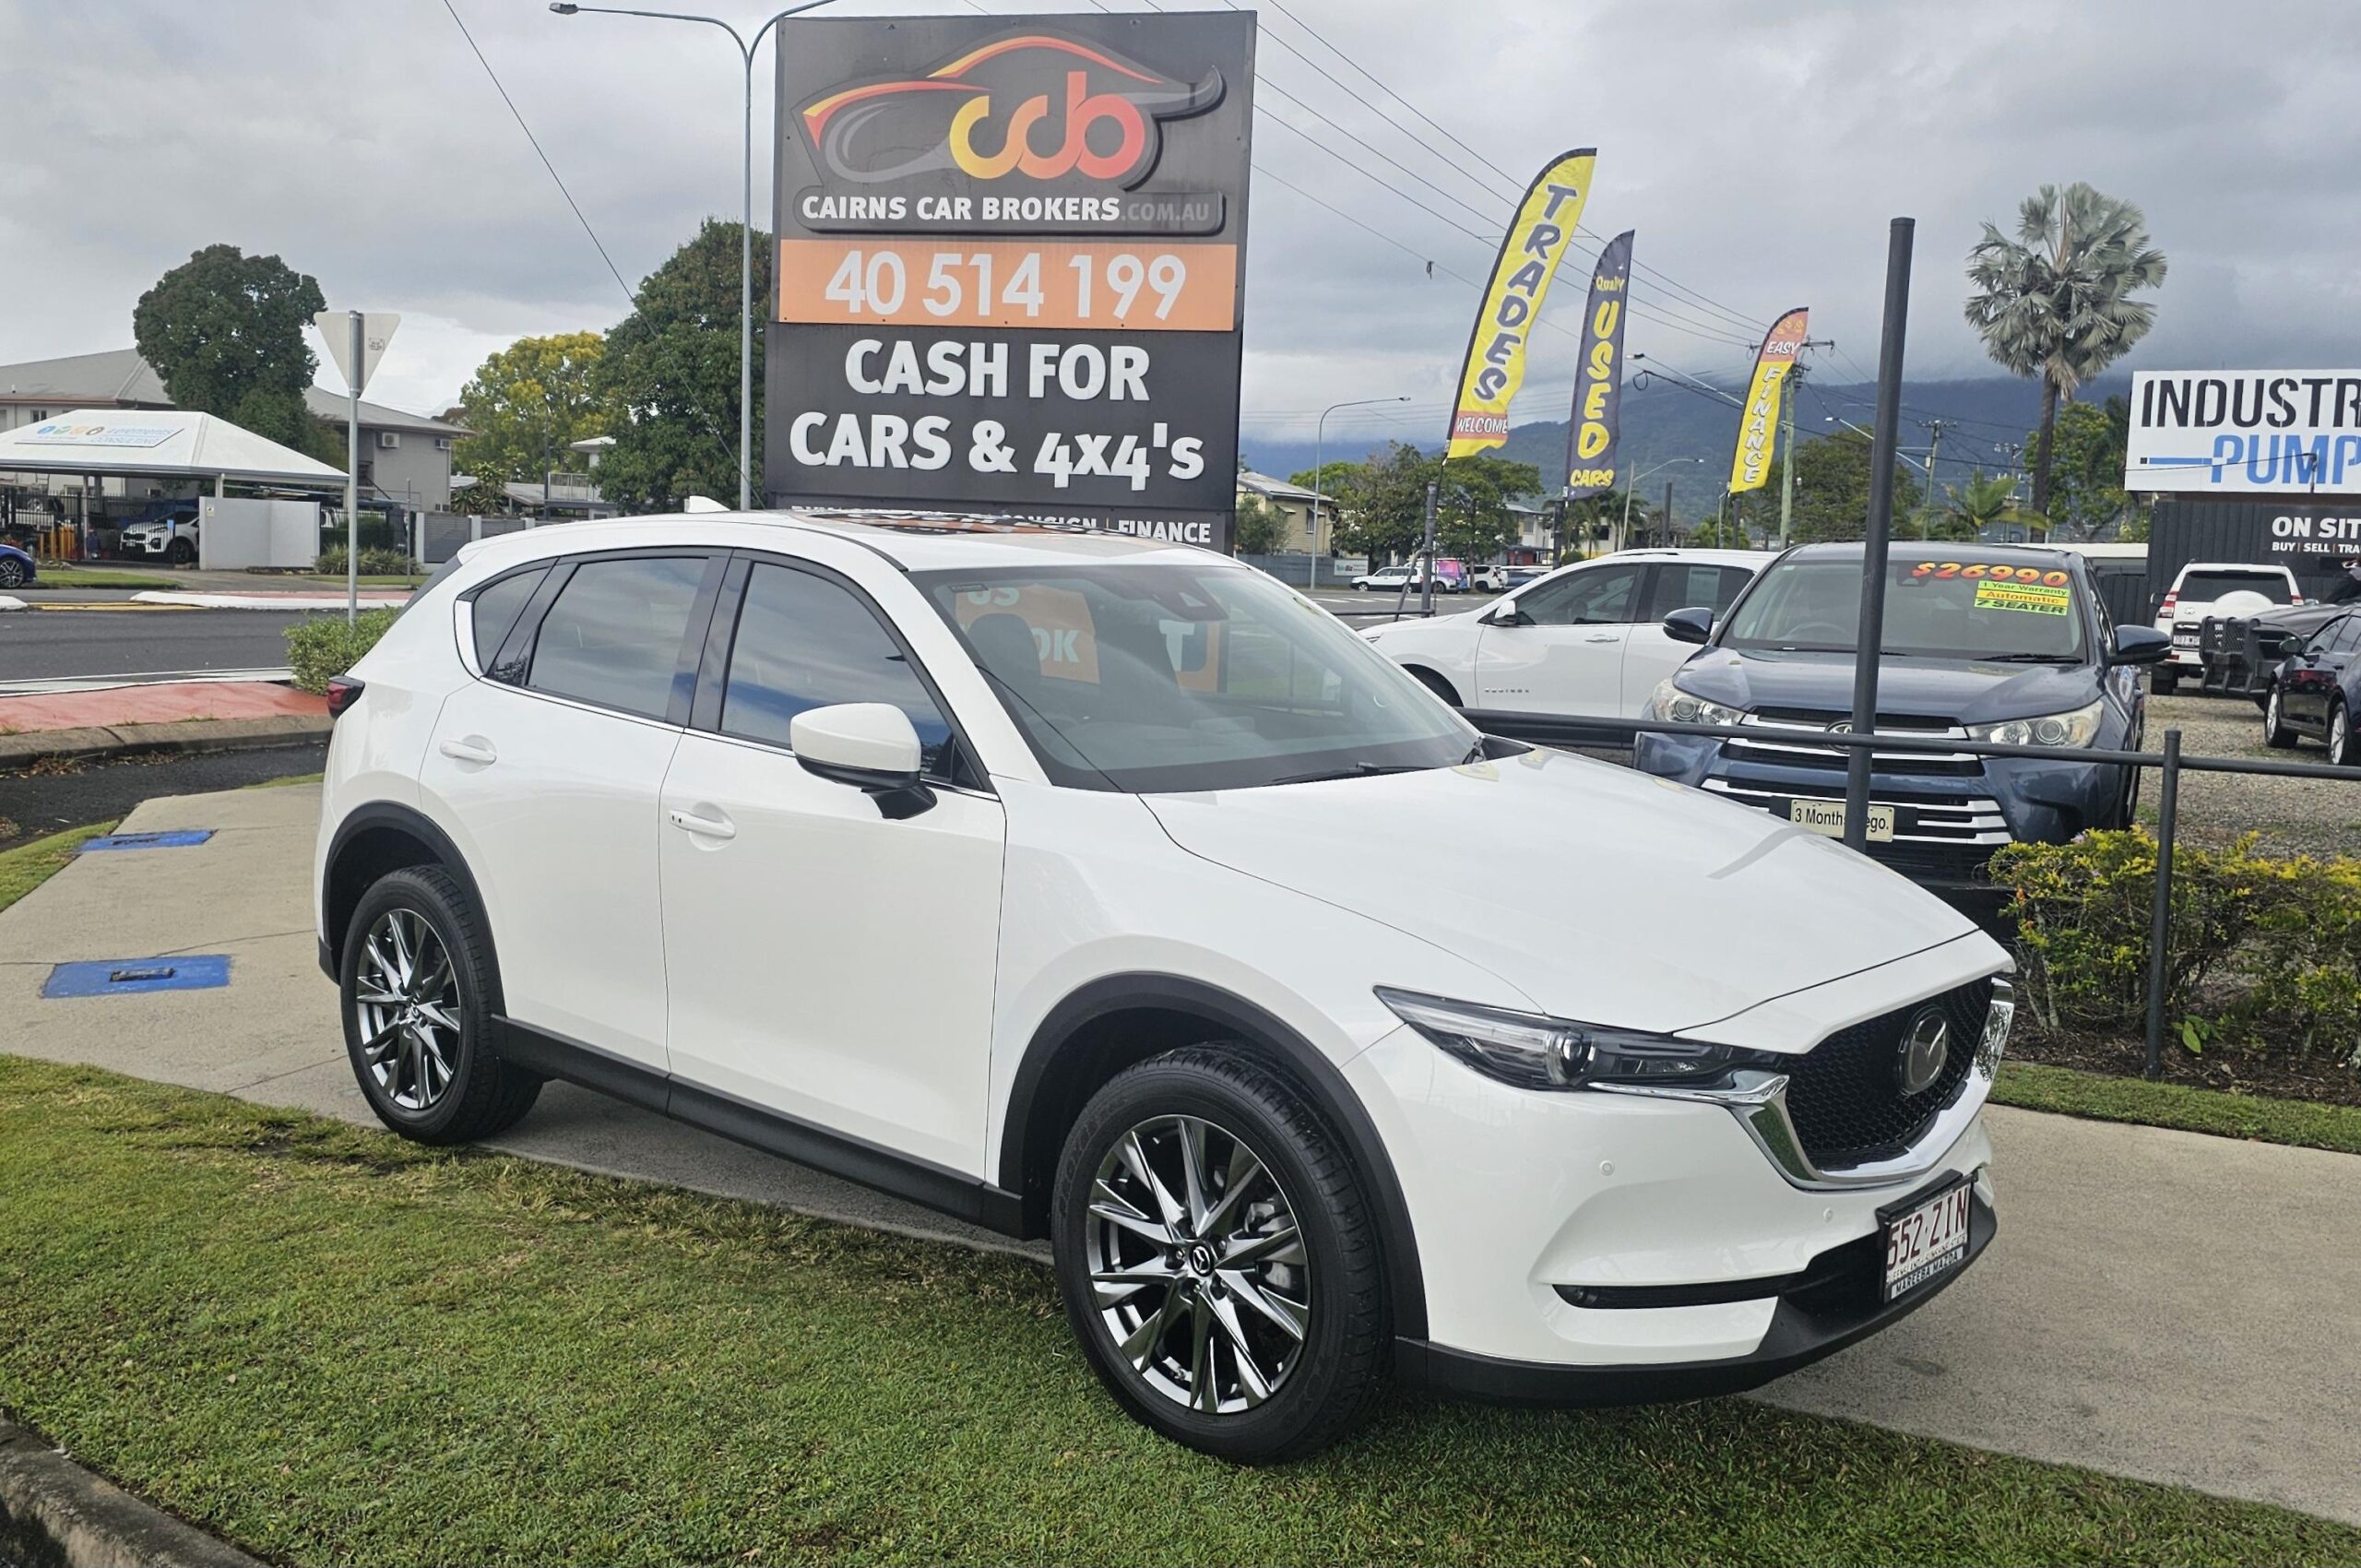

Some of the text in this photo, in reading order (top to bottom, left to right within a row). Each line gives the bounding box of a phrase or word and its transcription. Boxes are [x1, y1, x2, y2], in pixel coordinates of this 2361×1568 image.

[802, 196, 908, 220] CAIRNS
[917, 196, 972, 221] CAR
[825, 250, 1187, 321] 40 514 199
[1474, 184, 1577, 400] TRADES
[1766, 341, 1799, 355] EASY
[845, 339, 1150, 401] CASH FOR
[1578, 301, 1619, 459] USED
[2141, 378, 2361, 428] INDUSTR
[1457, 417, 1507, 434] WELCOME
[1743, 367, 1782, 482] FINANCE
[789, 411, 953, 470] CARS
[968, 419, 1018, 473] &
[2211, 434, 2361, 485] PUMP
[1570, 469, 1615, 487] CARS
[1119, 519, 1211, 543] FINANCE
[2272, 517, 2361, 540] ON SIT
[2272, 541, 2361, 553] BUY SELL TRA
[1911, 562, 2069, 588] $26990
[1986, 591, 2059, 604] Automatic
[1992, 582, 2015, 590] Year
[2019, 584, 2068, 596] Warranty
[1991, 600, 2065, 614] SEATER
[1795, 808, 1889, 833] 3 Month ego.
